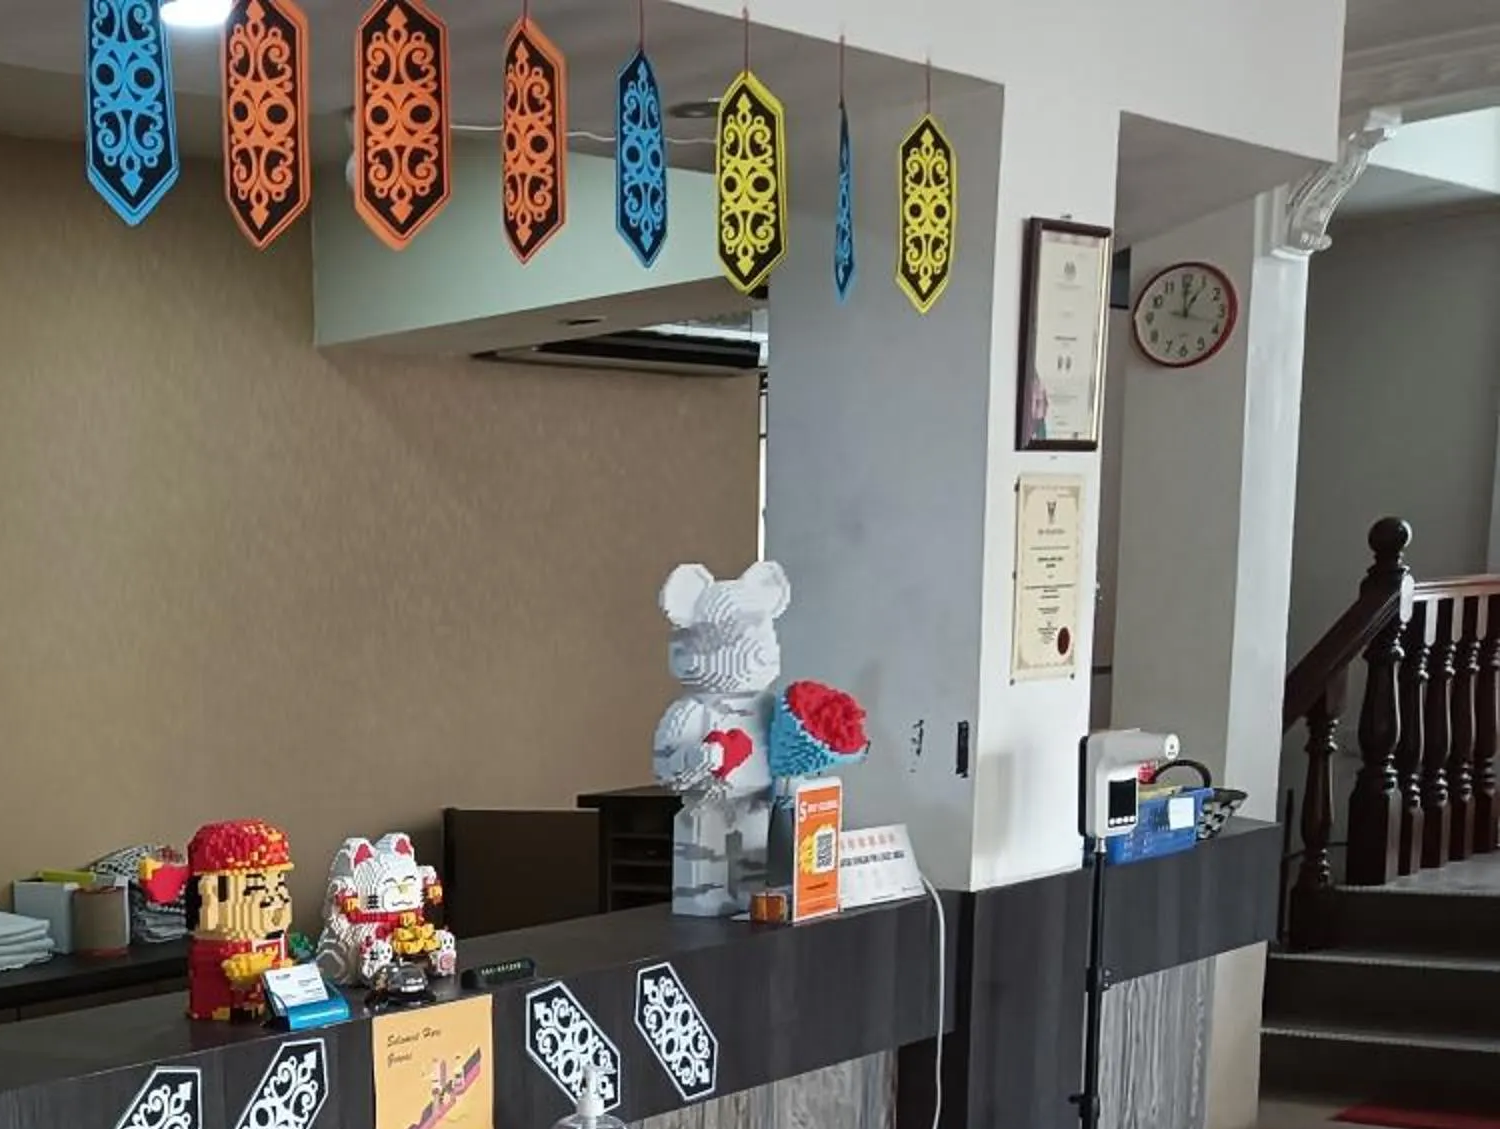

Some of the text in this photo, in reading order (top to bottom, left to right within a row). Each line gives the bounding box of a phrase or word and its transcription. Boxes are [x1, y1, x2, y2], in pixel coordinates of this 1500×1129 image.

[1212, 287, 1221, 301] 2
[1165, 340, 1173, 353] 7
[1180, 344, 1188, 357] 6
[1197, 337, 1205, 351] 5
